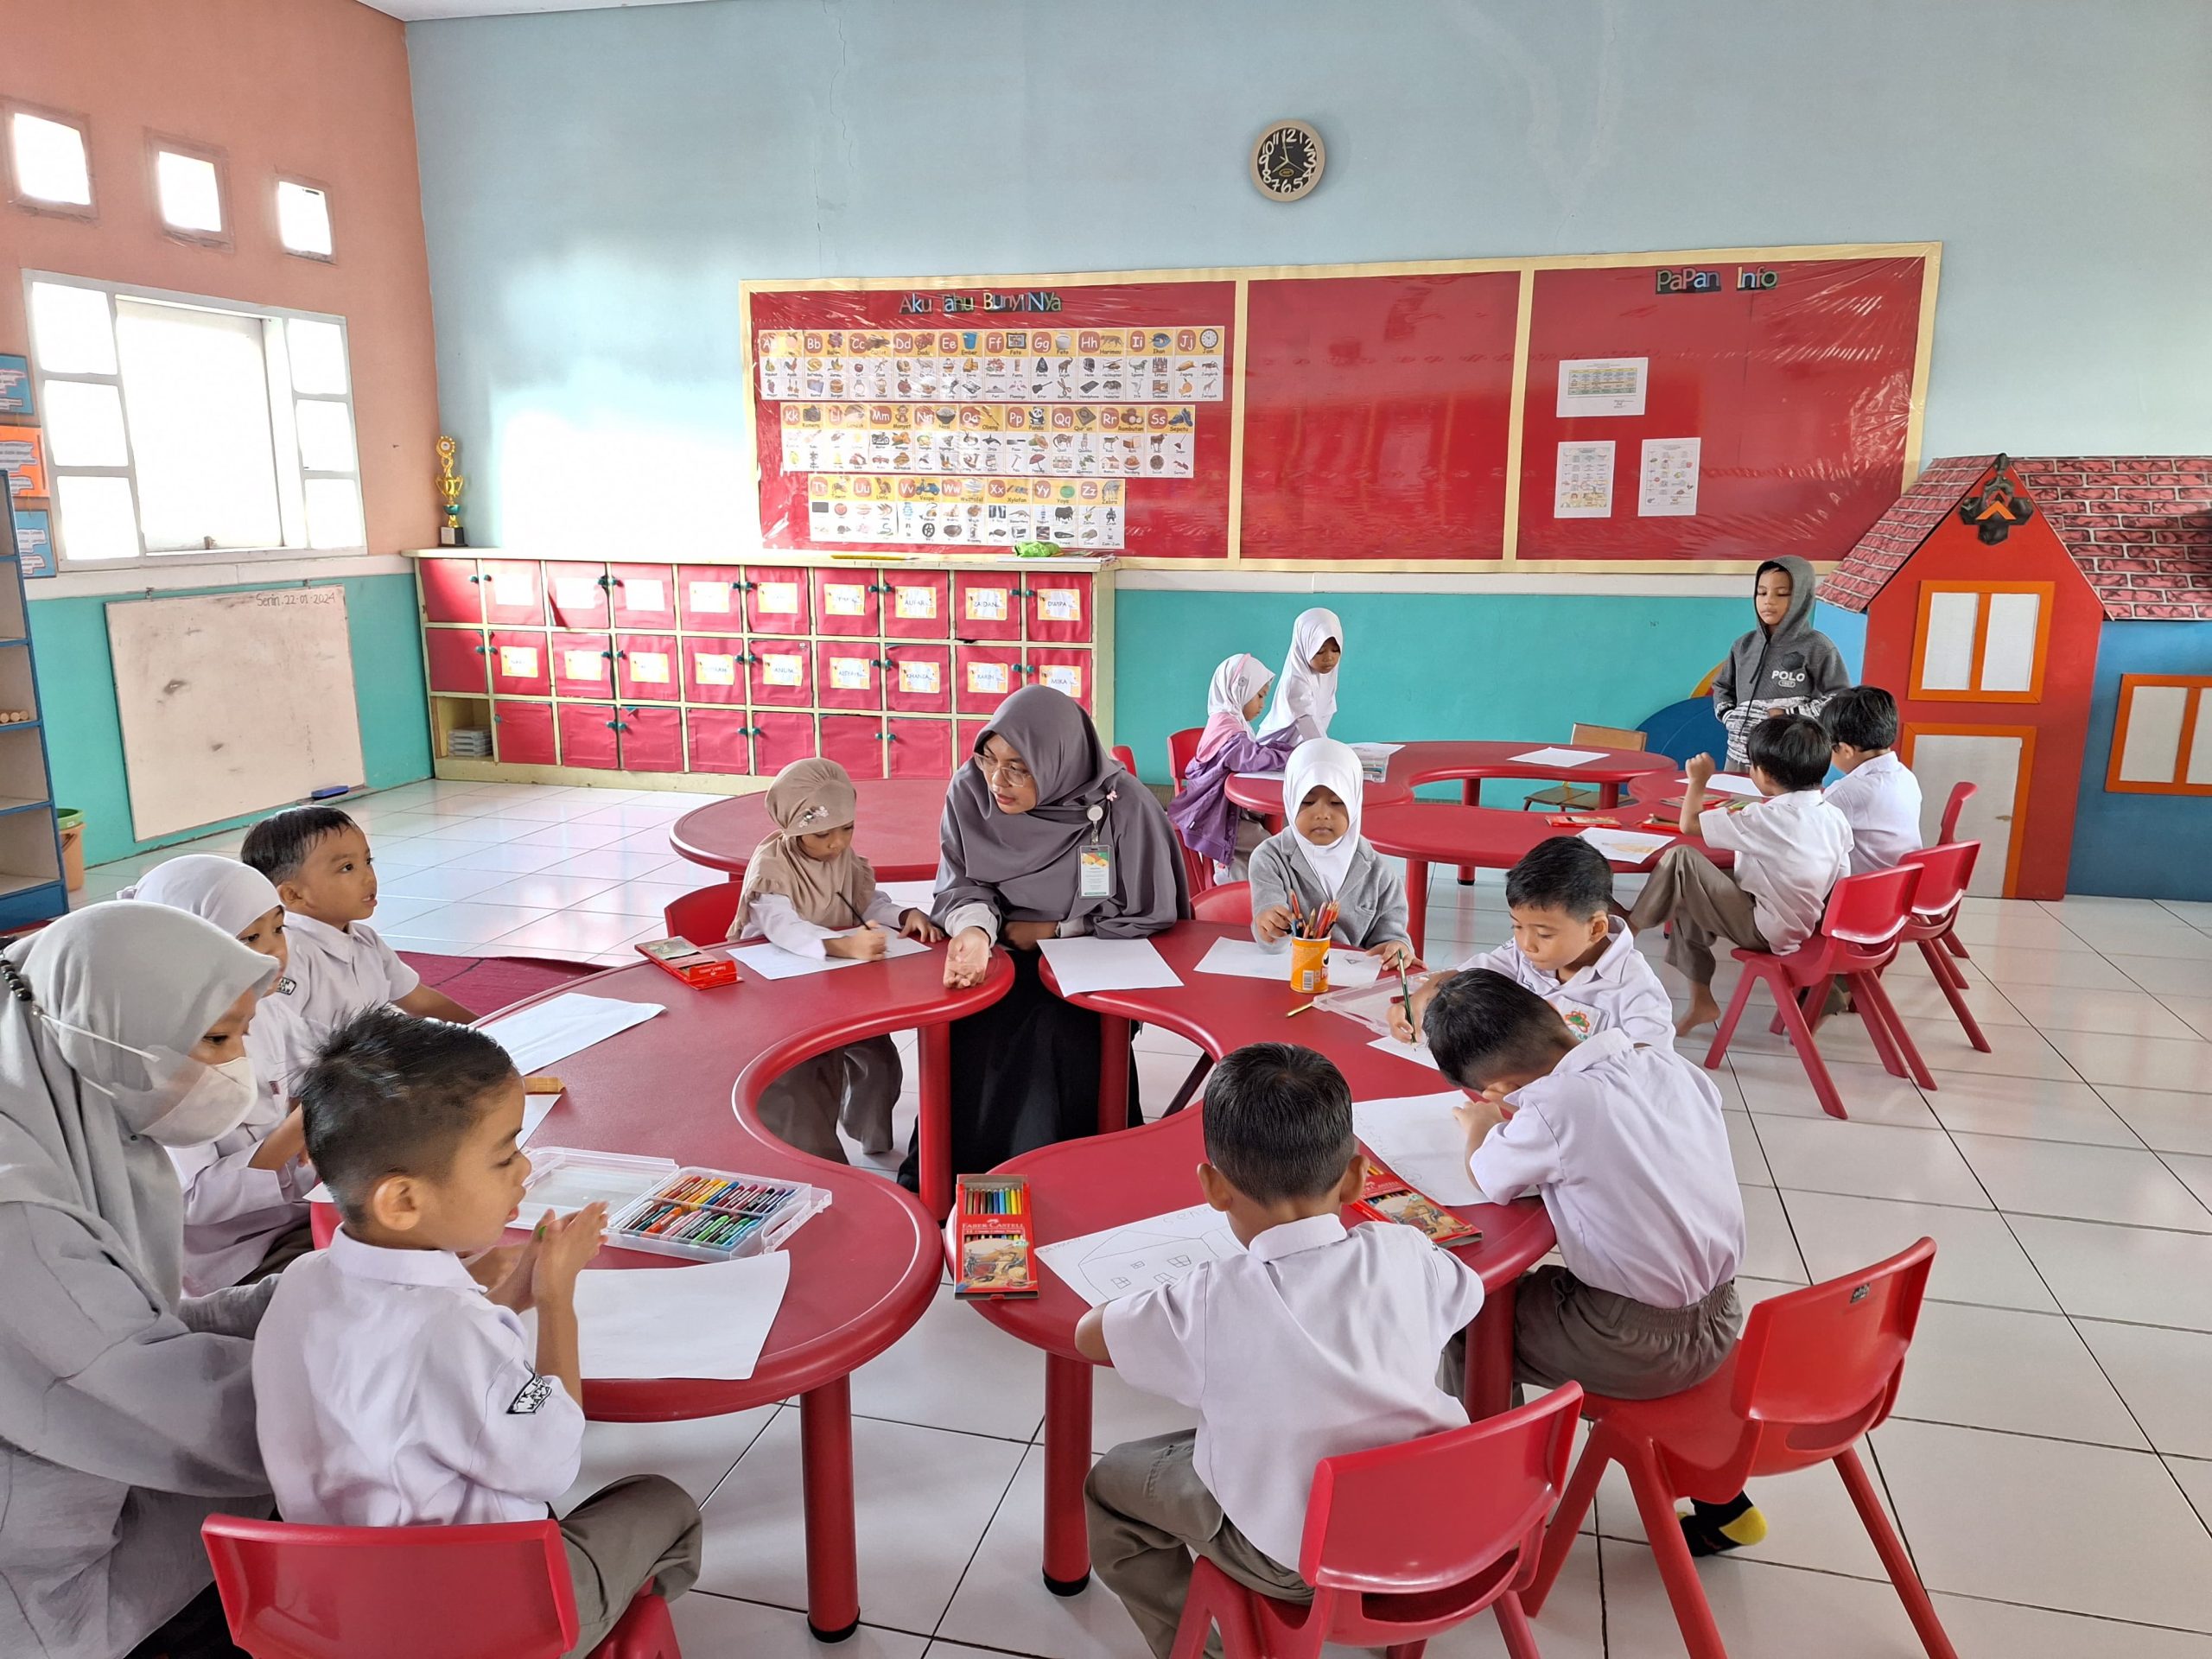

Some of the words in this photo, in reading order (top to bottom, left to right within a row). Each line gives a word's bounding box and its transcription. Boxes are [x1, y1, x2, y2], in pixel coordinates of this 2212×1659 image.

[1273, 132, 1280, 144] 11
[1300, 131, 1303, 144] 1
[1262, 141, 1274, 155] 10
[1304, 139, 1314, 152] 2
[1259, 156, 1269, 171] 9
[1304, 153, 1317, 168] 3
[1262, 170, 1271, 183] 8
[1302, 168, 1313, 181] 4
[1272, 180, 1280, 191] 7
[1281, 180, 1292, 193] 6
[1293, 178, 1303, 191] 5
[1738, 266, 1777, 289] Info
[899, 293, 932, 313] Aku
[807, 338, 821, 349] Bb
[852, 339, 865, 349] Cc
[896, 339, 912, 349] Dd
[943, 338, 957, 349] Ee
[988, 337, 1001, 350] Ff
[1034, 337, 1049, 351] Gg
[1082, 337, 1097, 349] Hh
[1132, 336, 1142, 348] Ii
[1180, 335, 1193, 351] Jj
[785, 412, 798, 421] Kk
[873, 411, 890, 421] Mm
[1010, 413, 1022, 427] Pp
[1055, 413, 1071, 427] Qq
[1103, 414, 1116, 424] Rr
[1151, 414, 1166, 424] Ss
[855, 484, 870, 493] Uu
[900, 483, 913, 493] Vv
[990, 485, 1003, 494] Xx
[1037, 485, 1050, 497] Yy
[1083, 486, 1096, 496] Zz
[1771, 671, 1805, 682] POLO
